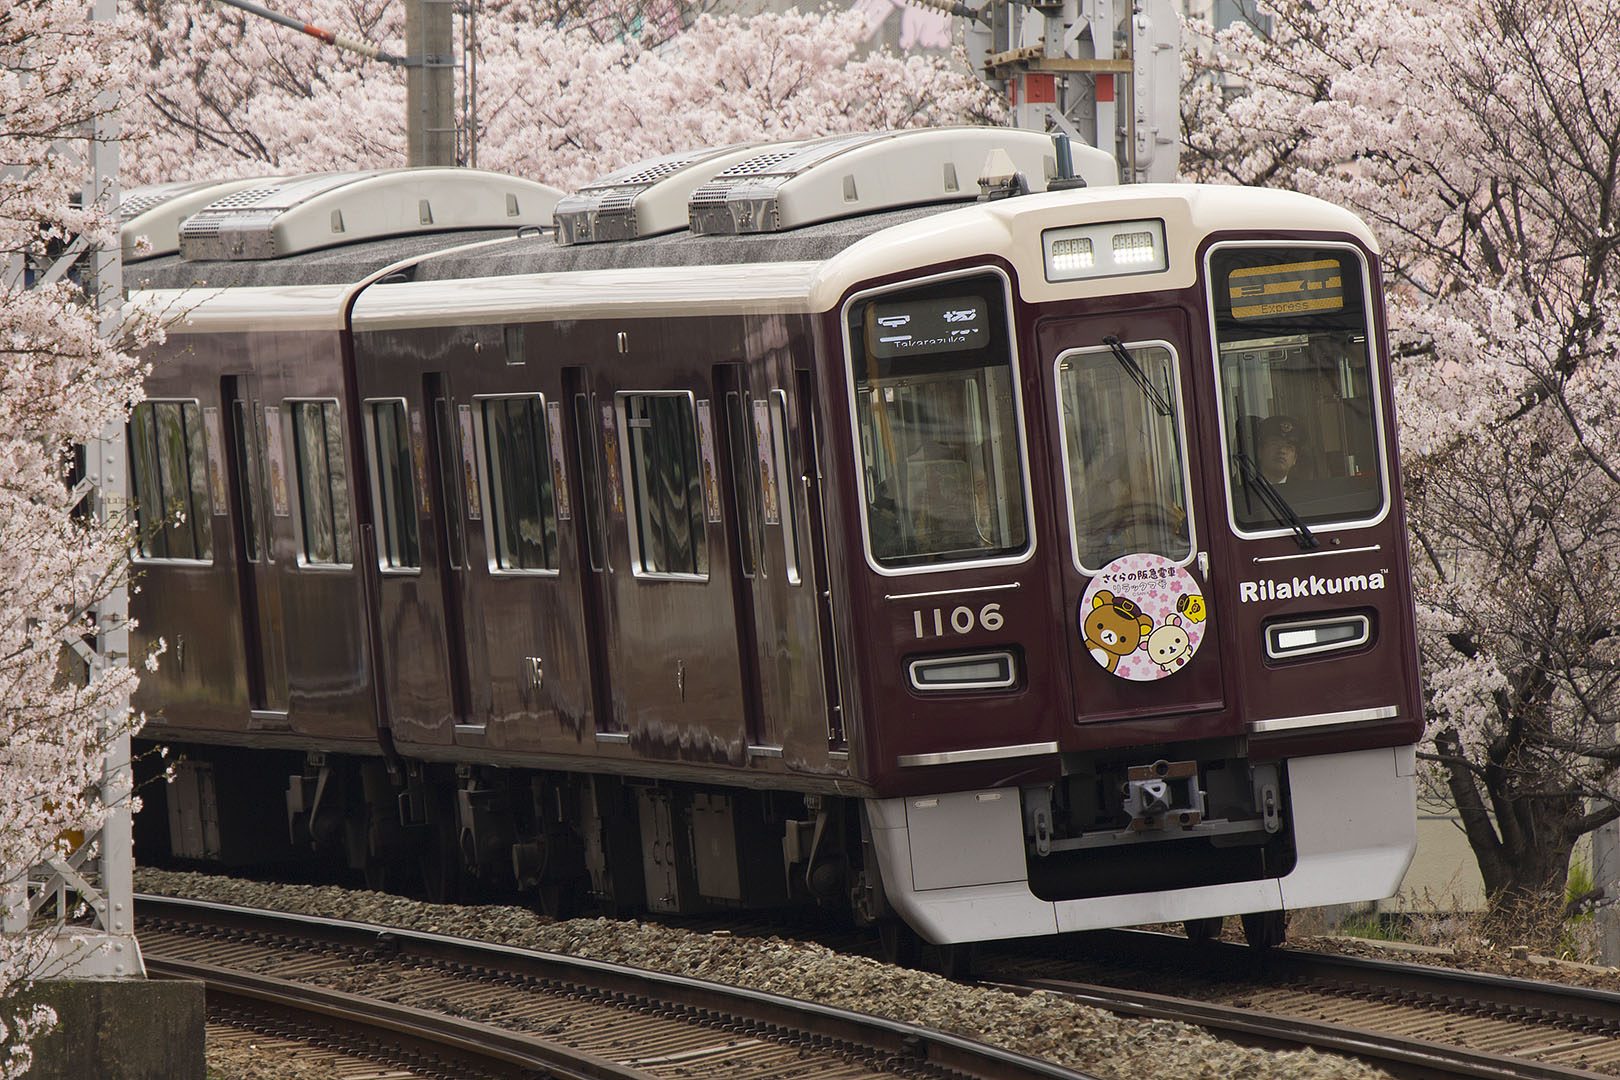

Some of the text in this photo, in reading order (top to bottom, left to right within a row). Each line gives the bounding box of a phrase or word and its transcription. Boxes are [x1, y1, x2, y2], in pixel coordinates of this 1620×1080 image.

[1261, 301, 1310, 314] Express
[893, 335, 966, 348] Takarazuka
[1102, 566, 1176, 584] さくらの阪急電車
[913, 603, 1004, 638] 1106
